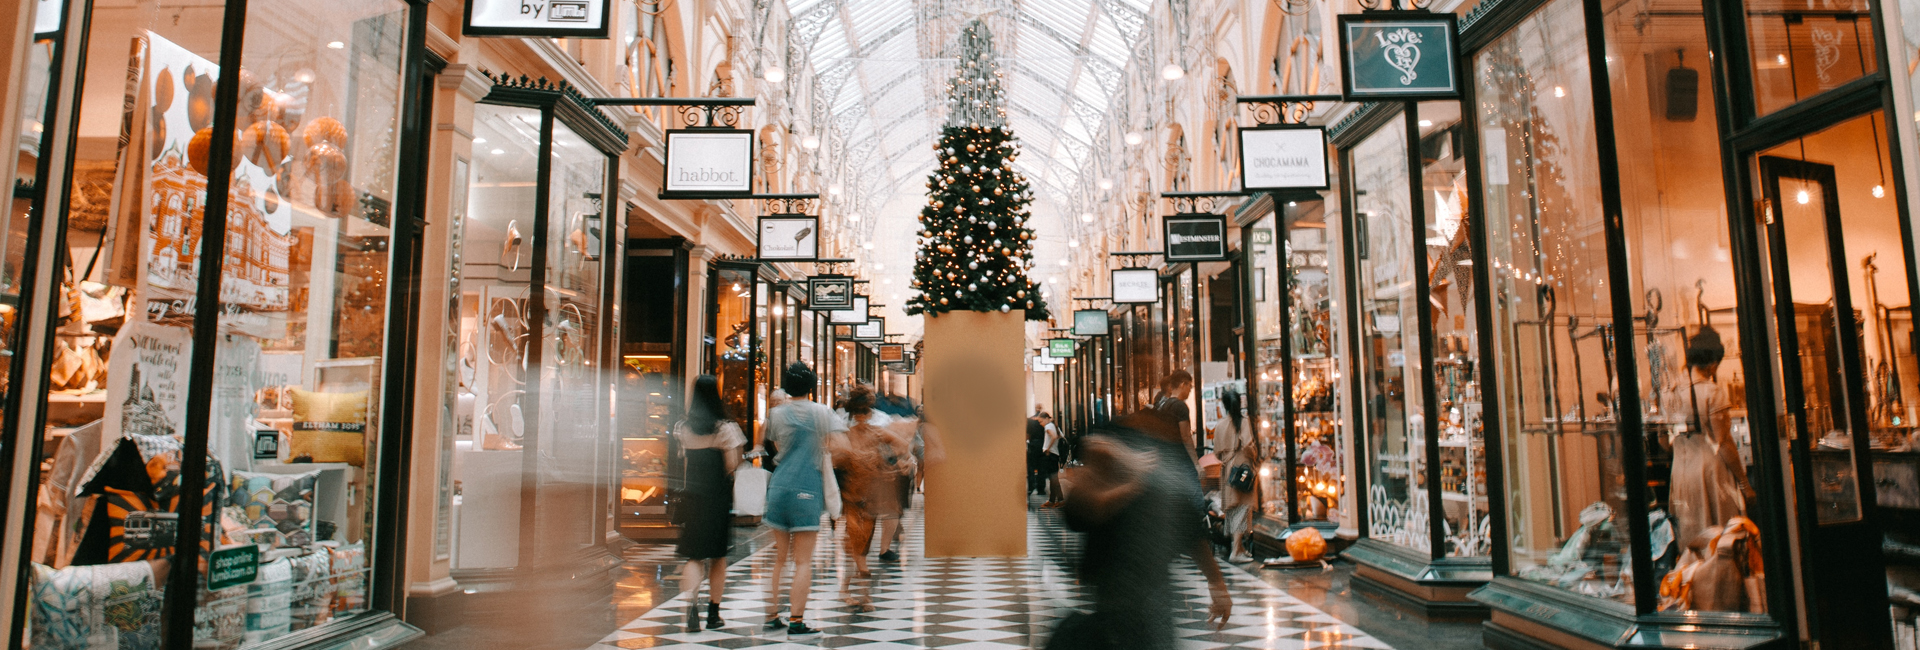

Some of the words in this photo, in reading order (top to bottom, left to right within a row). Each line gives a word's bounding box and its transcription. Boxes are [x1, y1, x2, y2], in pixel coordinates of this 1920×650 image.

[521, 0, 544, 19] by
[1253, 156, 1310, 168] CHOCAMAMA
[678, 167, 739, 182] habbot.
